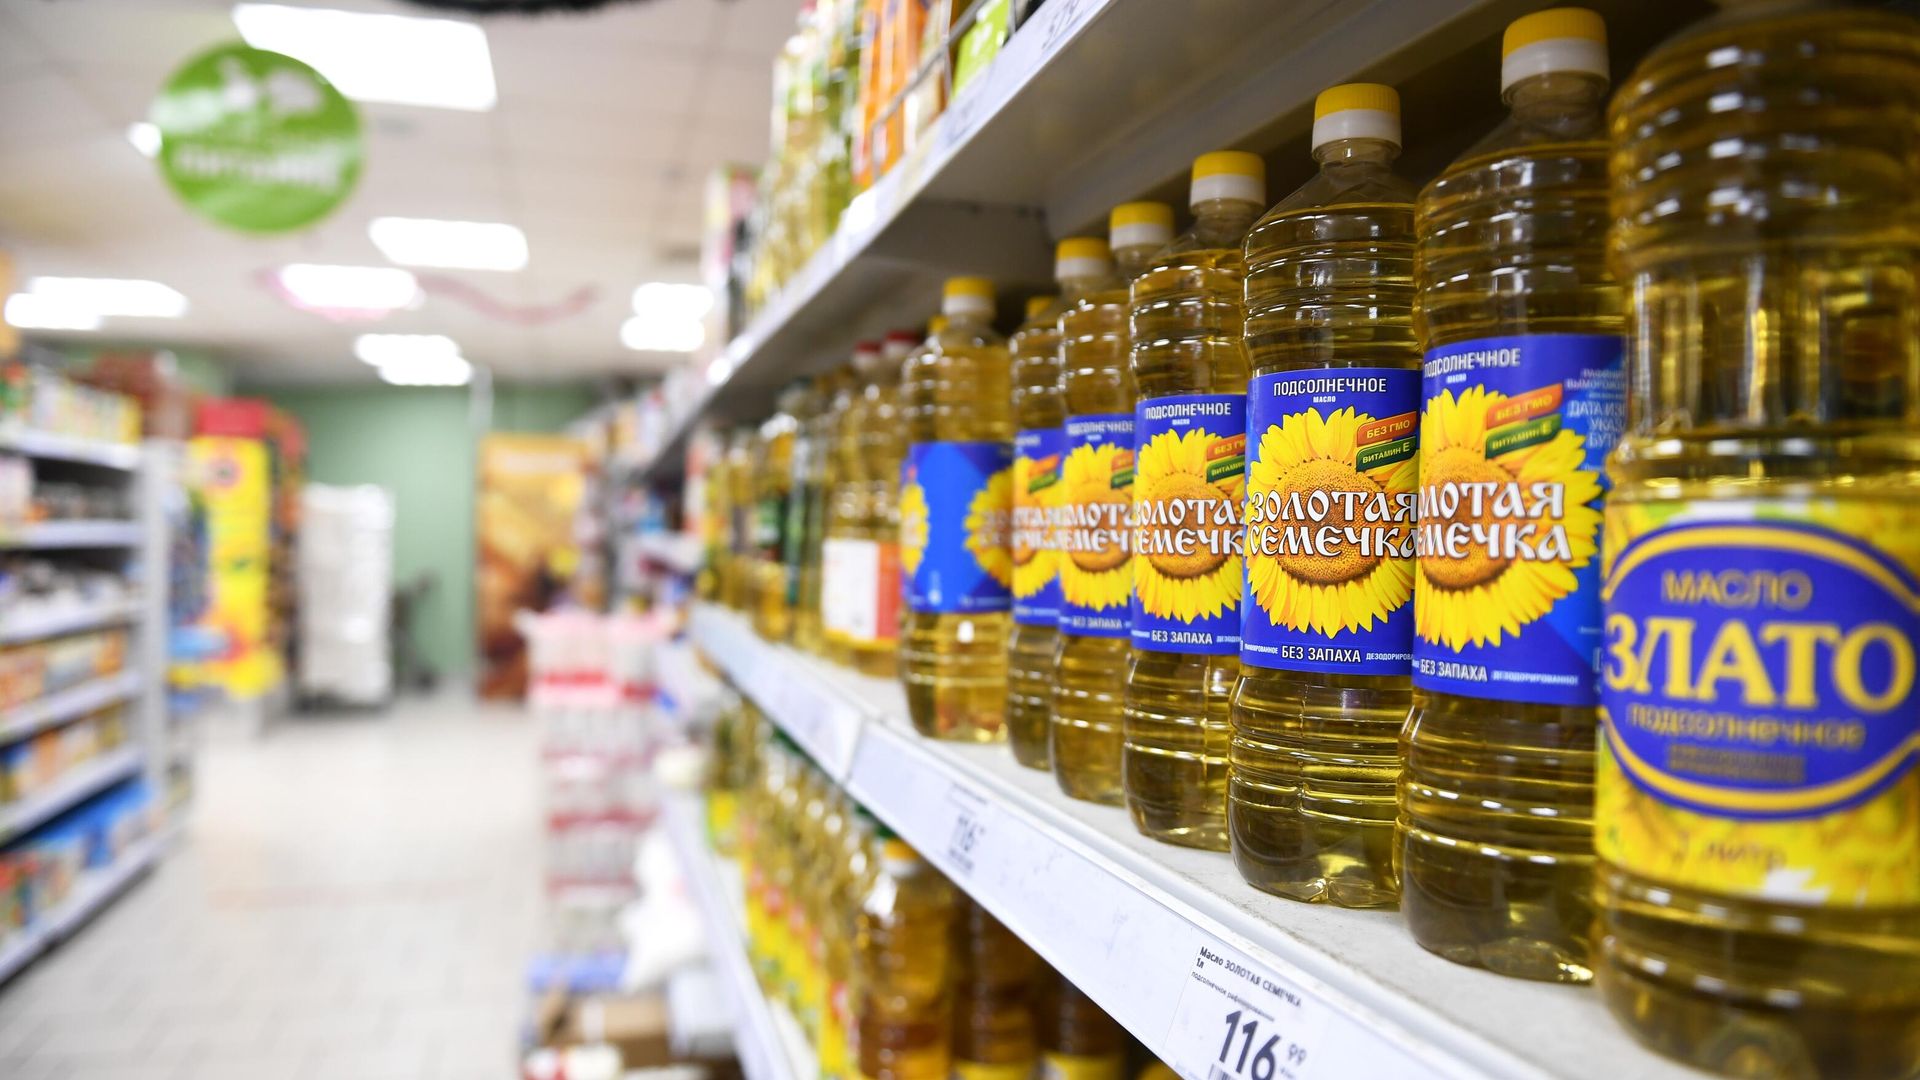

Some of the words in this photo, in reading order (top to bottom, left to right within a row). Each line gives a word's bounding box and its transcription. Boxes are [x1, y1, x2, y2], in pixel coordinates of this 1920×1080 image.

[1424, 348, 1521, 378] ПОДСОЛНЕЧНОЕ
[1273, 378, 1387, 396] ПОДСОЛНЕЧНОЕ
[1145, 402, 1232, 419] ПОДСОЛНЕЧНОЕ
[1496, 403, 1520, 420] БЕЗ
[1523, 395, 1552, 412] ГМО
[1366, 426, 1387, 439] БЕЗ
[1390, 420, 1410, 433] ГМО
[1492, 428, 1540, 449] ВИТАМИН
[1215, 443, 1233, 454] БЕЗ
[1362, 447, 1401, 464] ВИТАМИН
[1251, 489, 1418, 523] ЗОЛОТАЯ
[1663, 568, 1814, 611] МАСЛО
[1151, 630, 1169, 642] БЕЗ
[1170, 631, 1213, 644] ЗАПАХА
[1281, 645, 1304, 660] БЕЗ
[1307, 647, 1361, 663] ЗАПАХА
[1604, 613, 1916, 713] ЗЛАТО
[1420, 658, 1436, 675] БЕЗ
[1438, 661, 1488, 682] ЗАПАХА
[1627, 702, 1866, 750] ПОДСОЛНЕЧНОЕ
[1196, 957, 1205, 969] 1л
[1191, 971, 1228, 995] подсолнечное
[1199, 946, 1224, 966] Масло
[1224, 959, 1262, 986] ЗОЛОТАЯ
[1263, 980, 1302, 1008] СЕМЕЧКА
[1219, 1010, 1282, 1080] 116
[1288, 1043, 1307, 1066] 99
